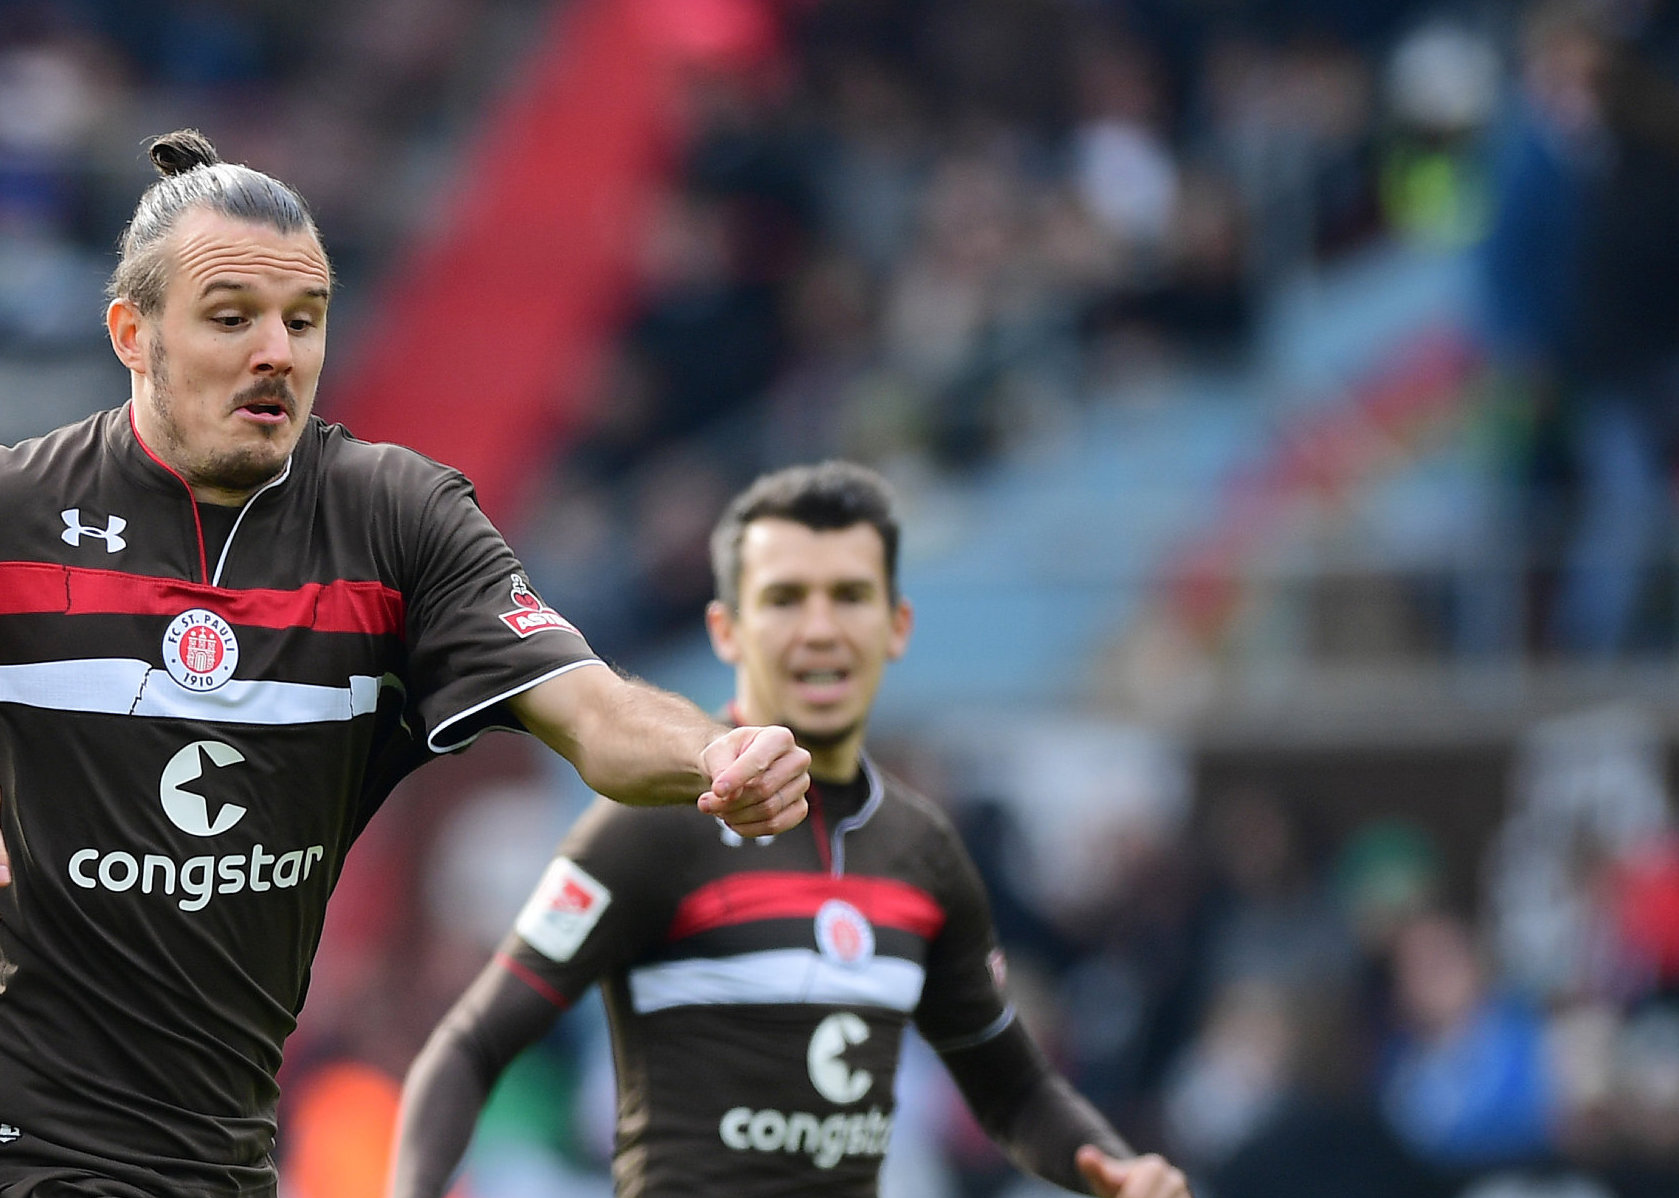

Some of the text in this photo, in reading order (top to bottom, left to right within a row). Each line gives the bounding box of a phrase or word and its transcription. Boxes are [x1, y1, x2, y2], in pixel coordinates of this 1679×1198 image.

[168, 614, 235, 651] FC ST. PAULI
[183, 673, 213, 687] 1910
[69, 844, 324, 912] congstar
